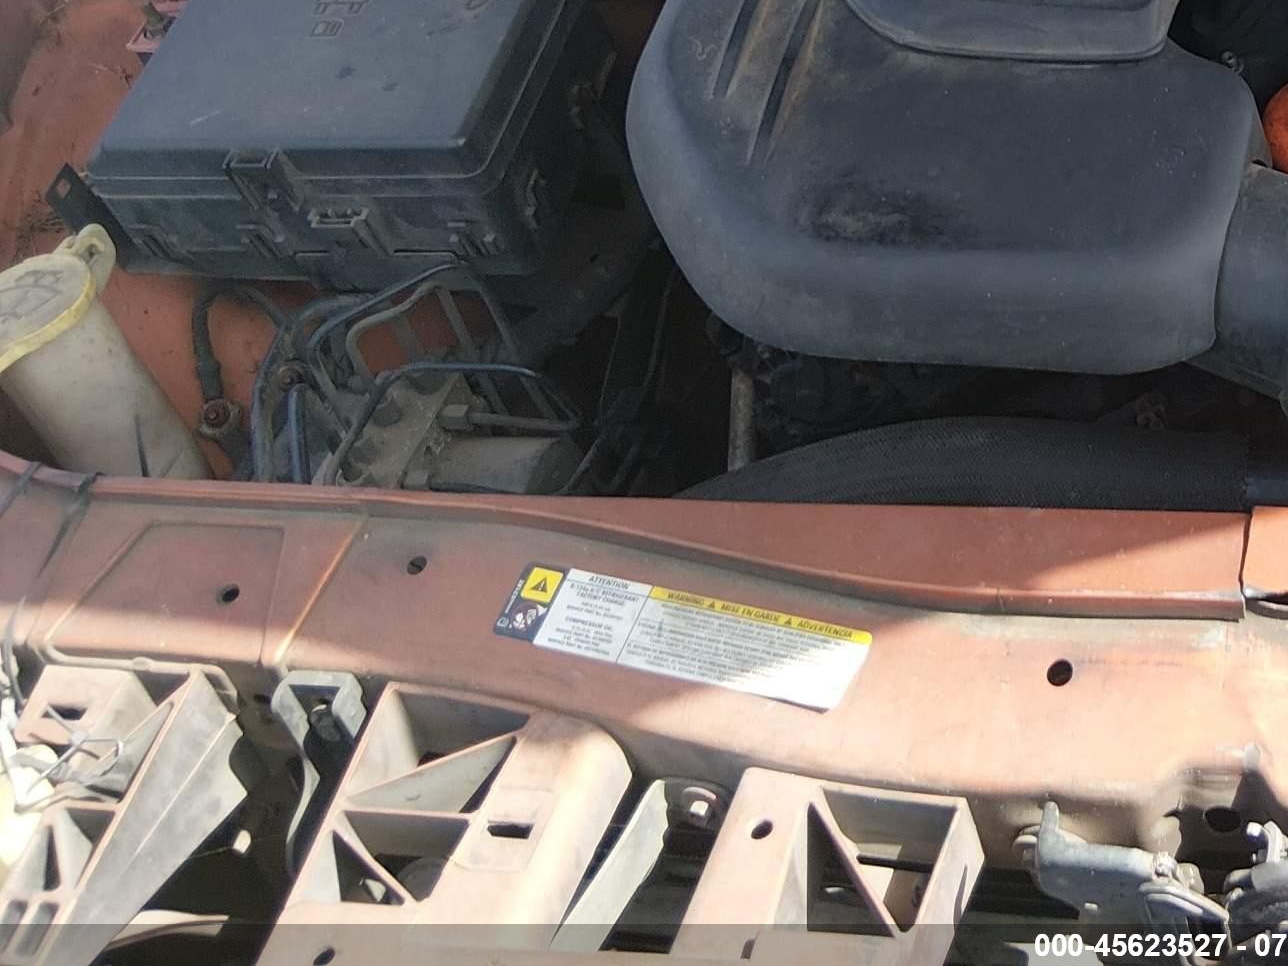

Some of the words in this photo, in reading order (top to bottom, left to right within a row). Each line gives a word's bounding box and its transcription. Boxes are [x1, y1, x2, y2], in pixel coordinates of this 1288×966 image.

[588, 575, 631, 590] ATTENTION
[667, 592, 705, 607] WARNING
[720, 602, 739, 614] MISE
[741, 607, 754, 617] EN
[797, 619, 853, 639] ADVERTENCIA
